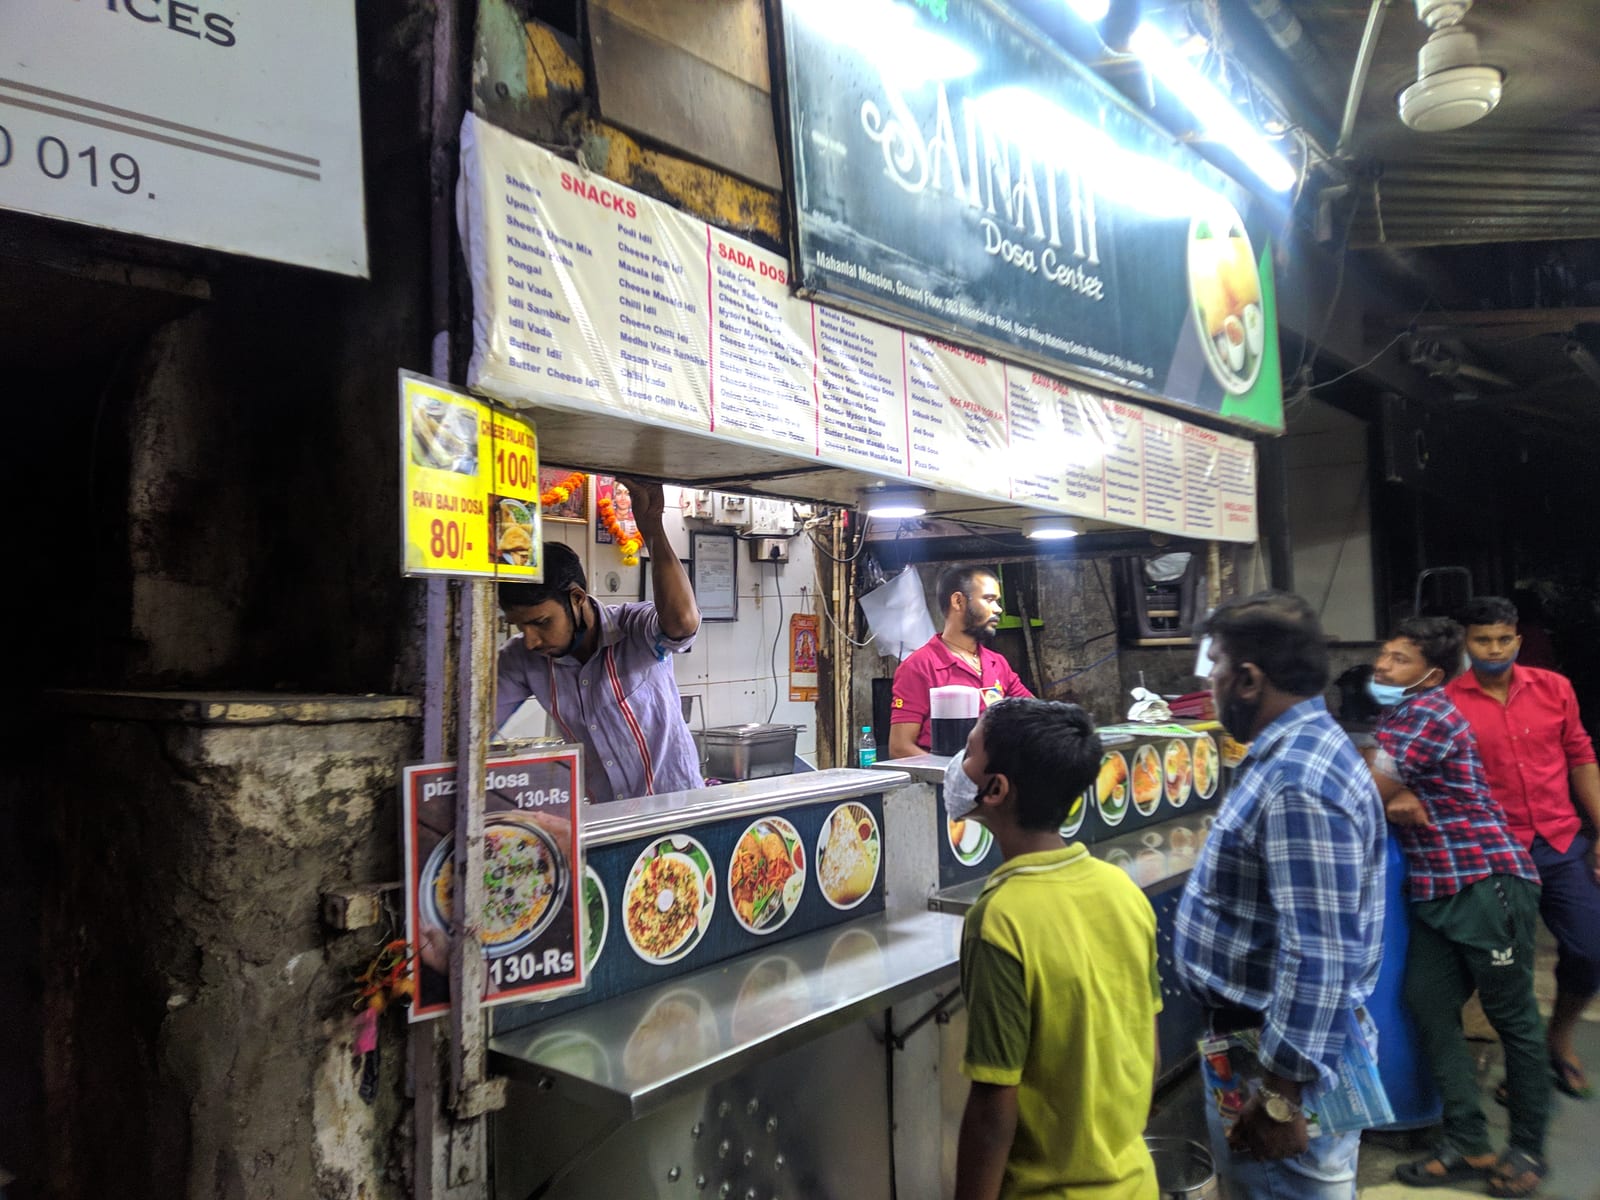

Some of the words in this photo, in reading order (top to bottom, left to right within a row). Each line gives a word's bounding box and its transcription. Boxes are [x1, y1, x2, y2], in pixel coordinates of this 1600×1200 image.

[37, 135, 156, 200] 019.
[561, 172, 636, 218] SNACKS
[506, 214, 543, 237] Sheera
[576, 242, 593, 256] Mix
[507, 255, 542, 276] Pongal
[618, 242, 650, 261] Cheese
[718, 242, 756, 273] SADA
[759, 263, 788, 286] DOS
[981, 218, 1038, 273] Dosa
[1041, 248, 1104, 300] Center
[619, 259, 649, 278] Masala
[858, 265, 895, 293] Mansion,
[508, 276, 525, 290] Dal
[527, 283, 553, 299] Vada
[619, 278, 650, 296] Cheese
[508, 295, 525, 310] Idli
[527, 302, 571, 324] Sambhar
[619, 314, 651, 332] Cheese
[508, 316, 525, 330] Idli
[527, 323, 553, 339] Vada
[509, 337, 541, 354] Butter
[509, 357, 541, 374] Butter
[546, 368, 583, 385] Cheese
[497, 449, 536, 490] 100/-
[413, 490, 432, 509] PAV
[436, 495, 459, 513] BAJI
[461, 498, 484, 516] DOSA
[430, 519, 472, 560] 80/-
[424, 777, 457, 802] piz
[486, 772, 529, 790] dosa
[515, 788, 570, 809] 130-Rs
[489, 948, 574, 985] 130-Rs
